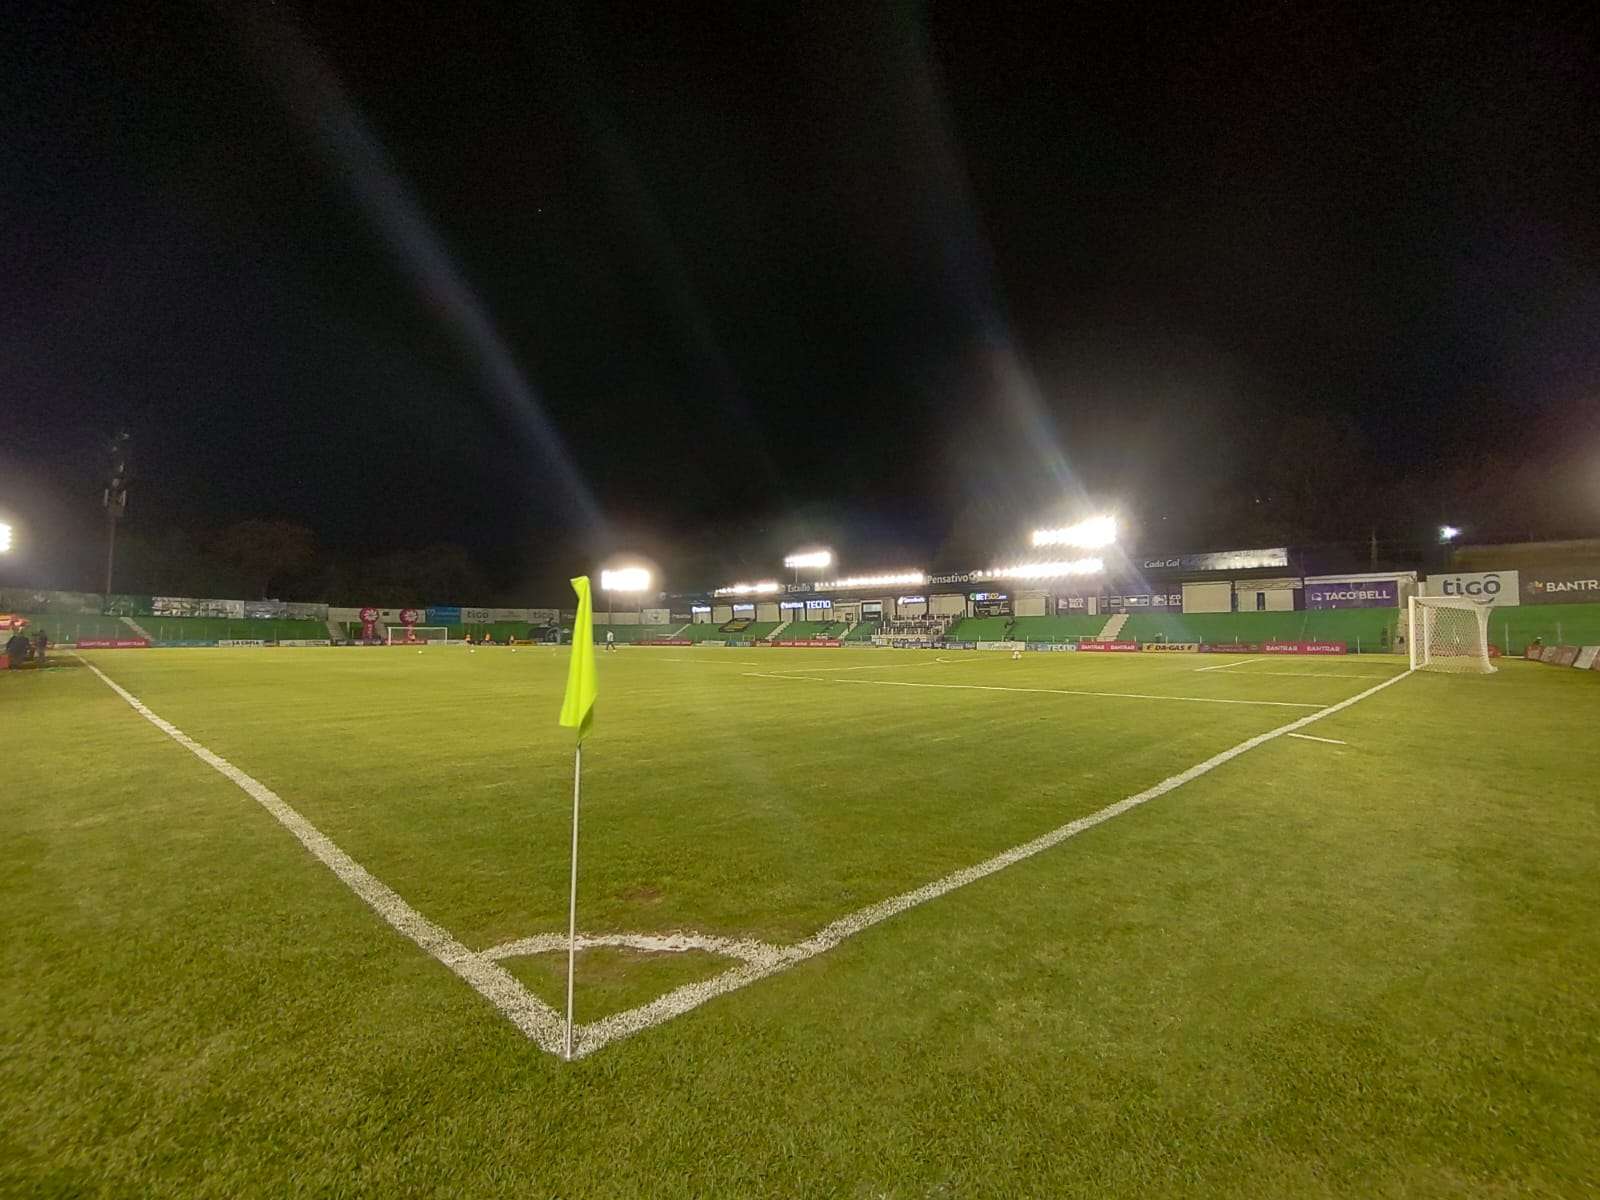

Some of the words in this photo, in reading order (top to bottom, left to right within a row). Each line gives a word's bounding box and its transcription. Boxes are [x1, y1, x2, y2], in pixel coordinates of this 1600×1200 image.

[928, 572, 969, 584] Pensativo
[1443, 574, 1500, 595] tigo
[1546, 580, 1600, 592] BANTR
[1323, 591, 1356, 600] TACO
[1360, 590, 1391, 599] BELL
[806, 600, 831, 608] TECNO
